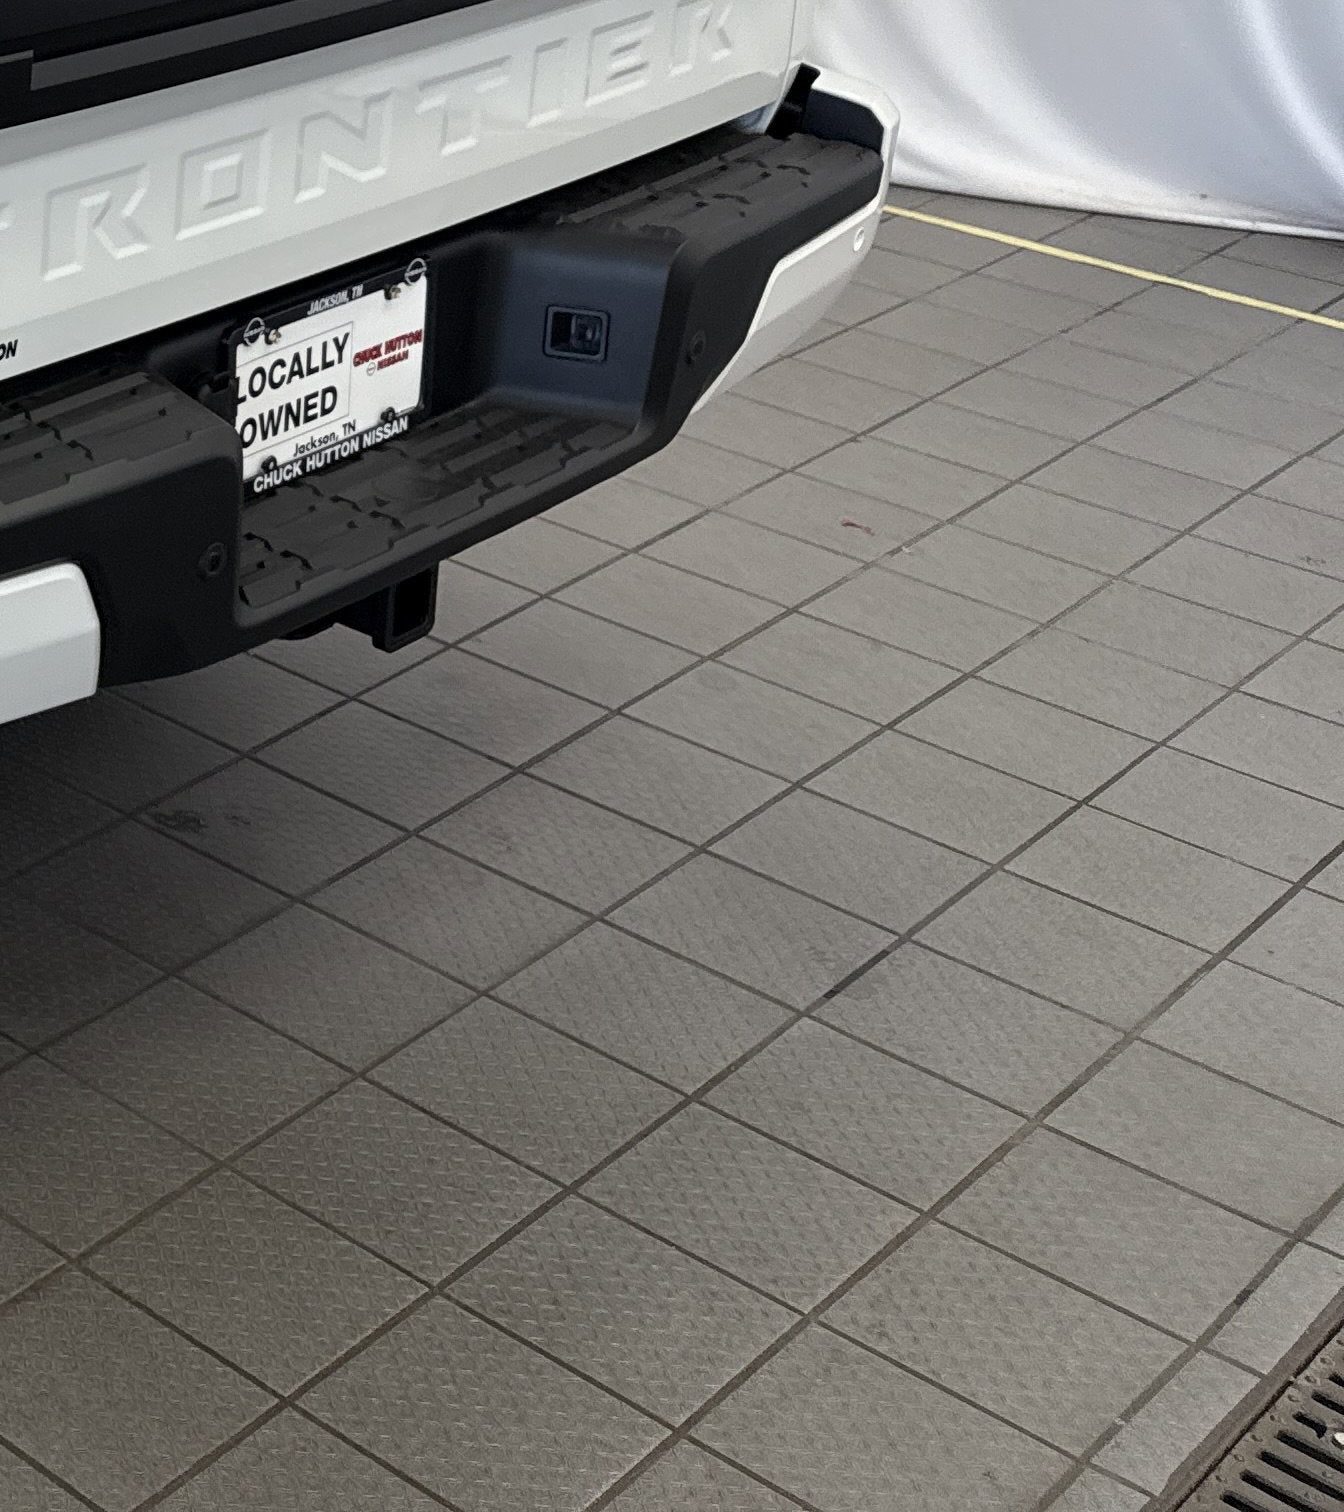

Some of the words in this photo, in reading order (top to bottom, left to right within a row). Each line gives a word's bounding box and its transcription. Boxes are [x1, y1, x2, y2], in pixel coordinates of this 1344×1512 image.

[236, 332, 350, 405] LOCALLY
[239, 385, 337, 449] OWNED
[293, 429, 339, 458] Jackson,
[342, 419, 357, 436] TN
[253, 461, 303, 493] CHUCK
[305, 435, 360, 473] HUTTON
[362, 415, 409, 449] NISSAN
